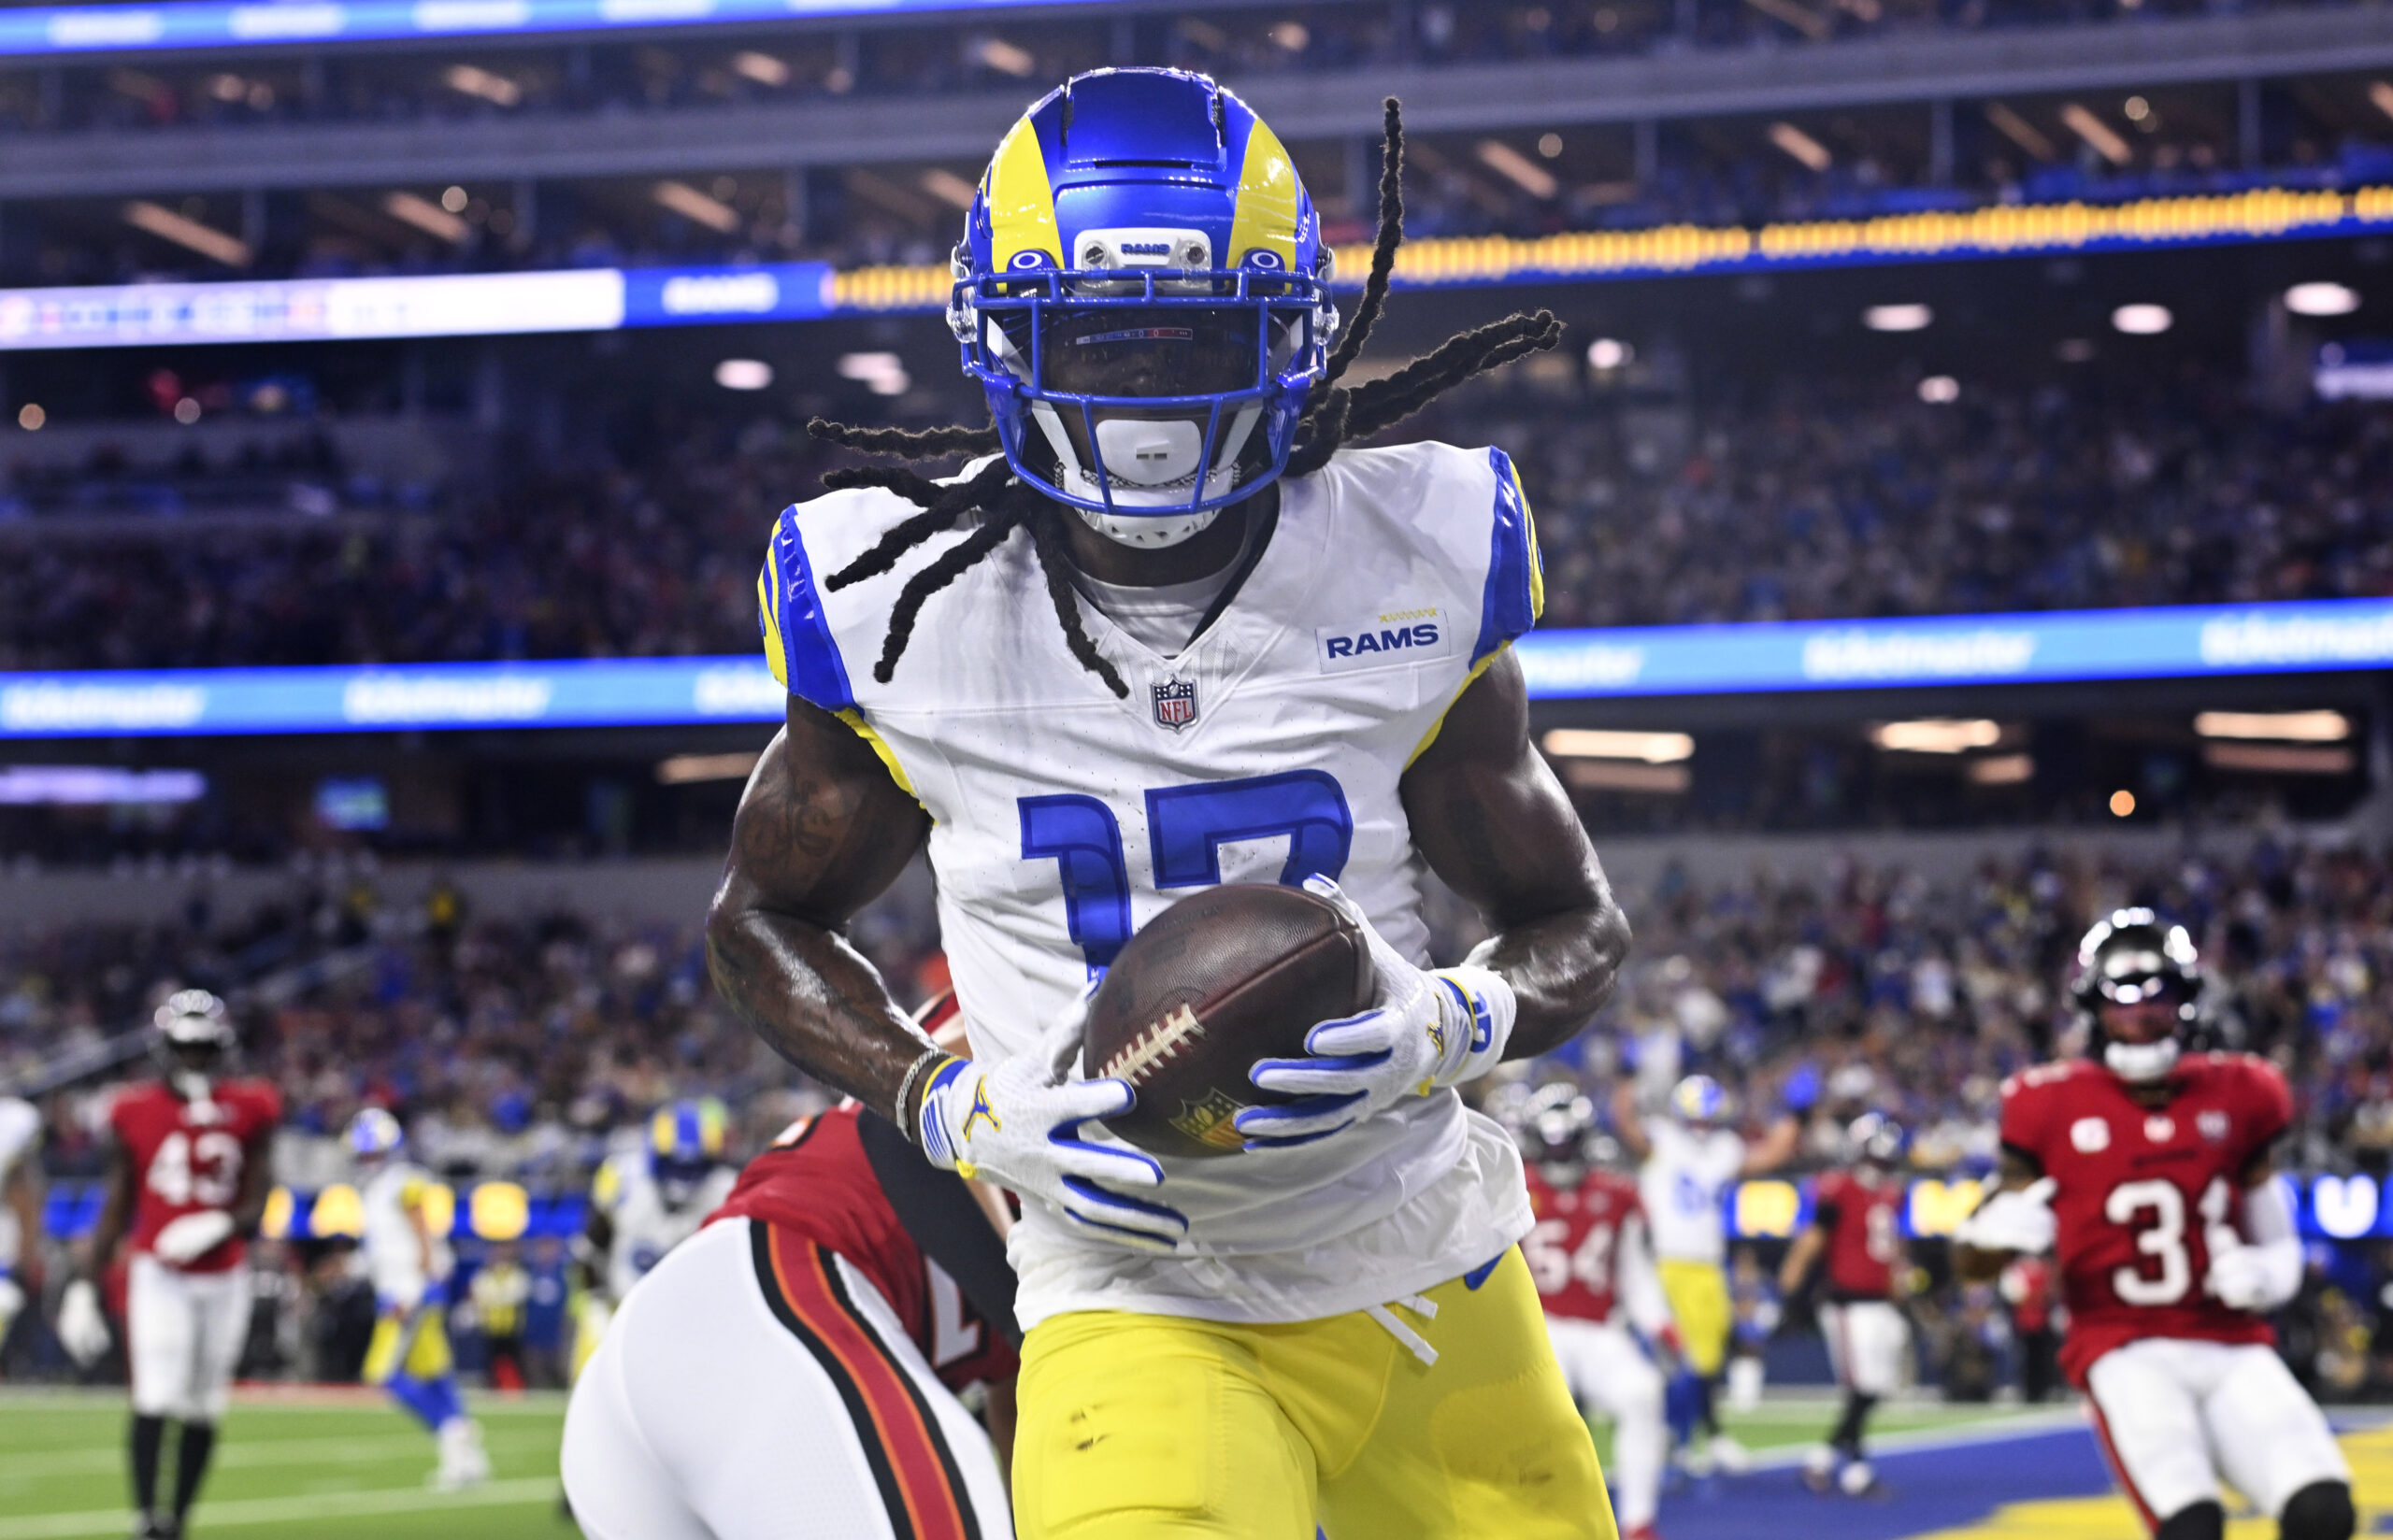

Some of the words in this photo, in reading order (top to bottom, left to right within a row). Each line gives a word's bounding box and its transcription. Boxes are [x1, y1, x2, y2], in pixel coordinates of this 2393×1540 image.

[1121, 243, 1170, 255] RAMS
[1325, 623, 1439, 659] RAMS
[1160, 700, 1193, 722] NFL
[1017, 768, 1354, 983] 17
[145, 1130, 244, 1207] 43
